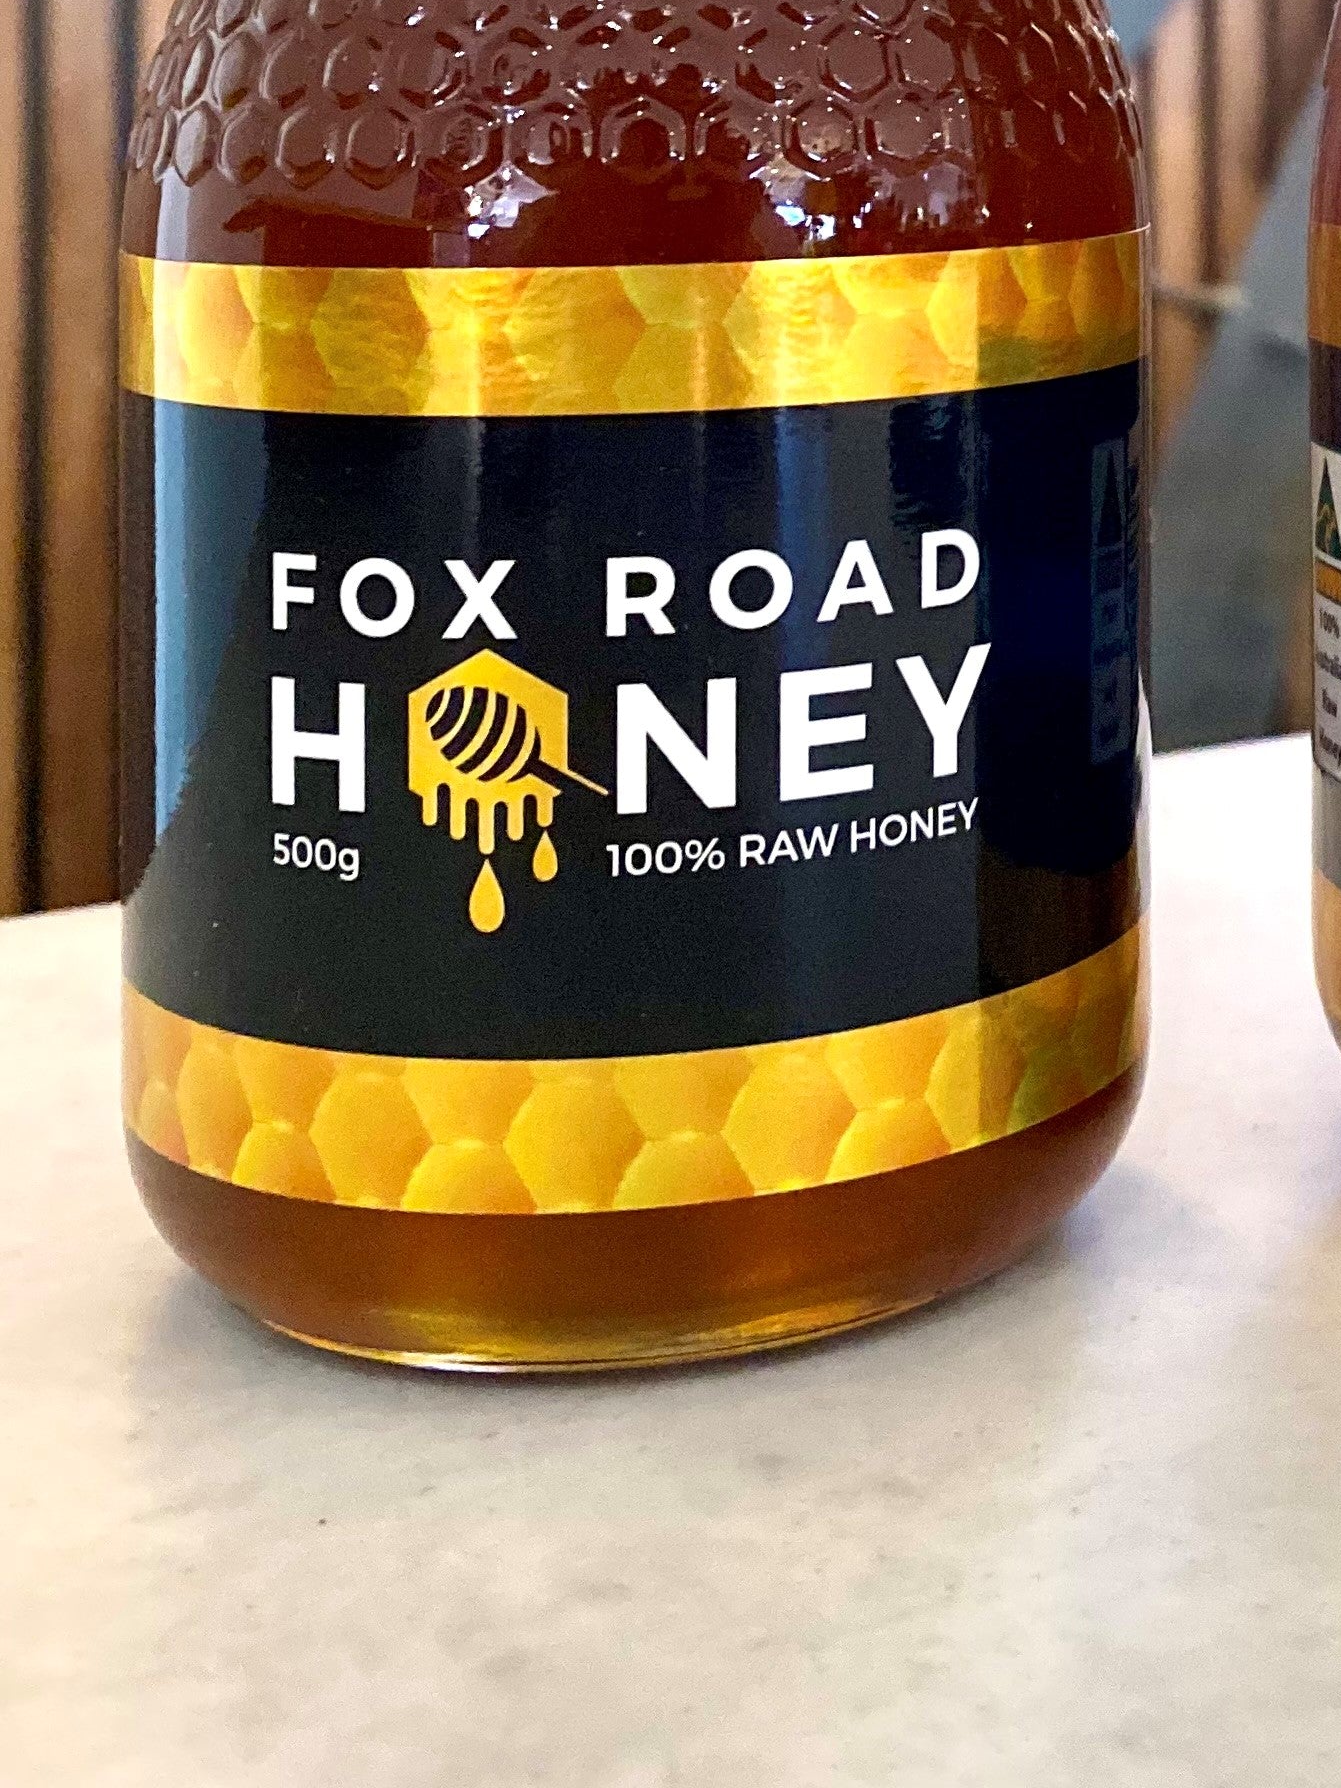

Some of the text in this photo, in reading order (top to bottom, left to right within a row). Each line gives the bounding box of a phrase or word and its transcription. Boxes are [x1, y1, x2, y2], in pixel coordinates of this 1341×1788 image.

[272, 528, 980, 640] FOX ROAD
[273, 832, 360, 881] 500g
[605, 796, 979, 877] 100% RAW HONEY
